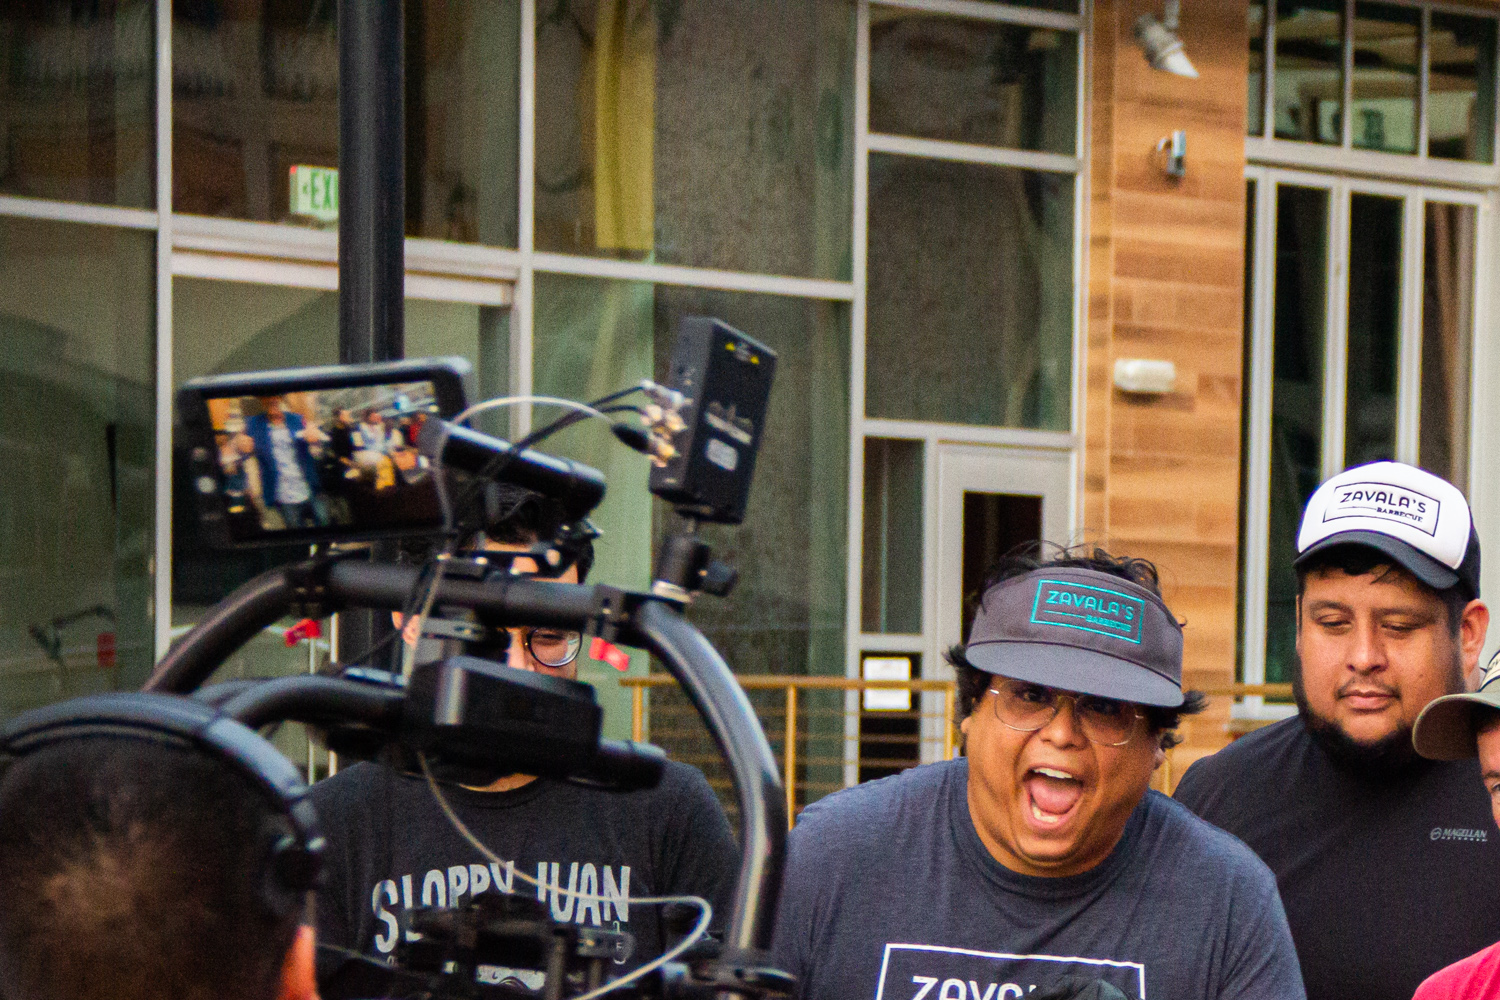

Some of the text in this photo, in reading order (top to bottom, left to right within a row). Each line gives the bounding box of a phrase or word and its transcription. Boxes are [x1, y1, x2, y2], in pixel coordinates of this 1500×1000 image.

[311, 172, 339, 210] EXI
[1339, 490, 1427, 514] ZAVALA'S
[1376, 507, 1424, 522] BARBECUE
[1045, 590, 1134, 620] ZAVALA'S
[1442, 828, 1488, 838] MAGELLAN
[372, 860, 515, 954] SLOPPY
